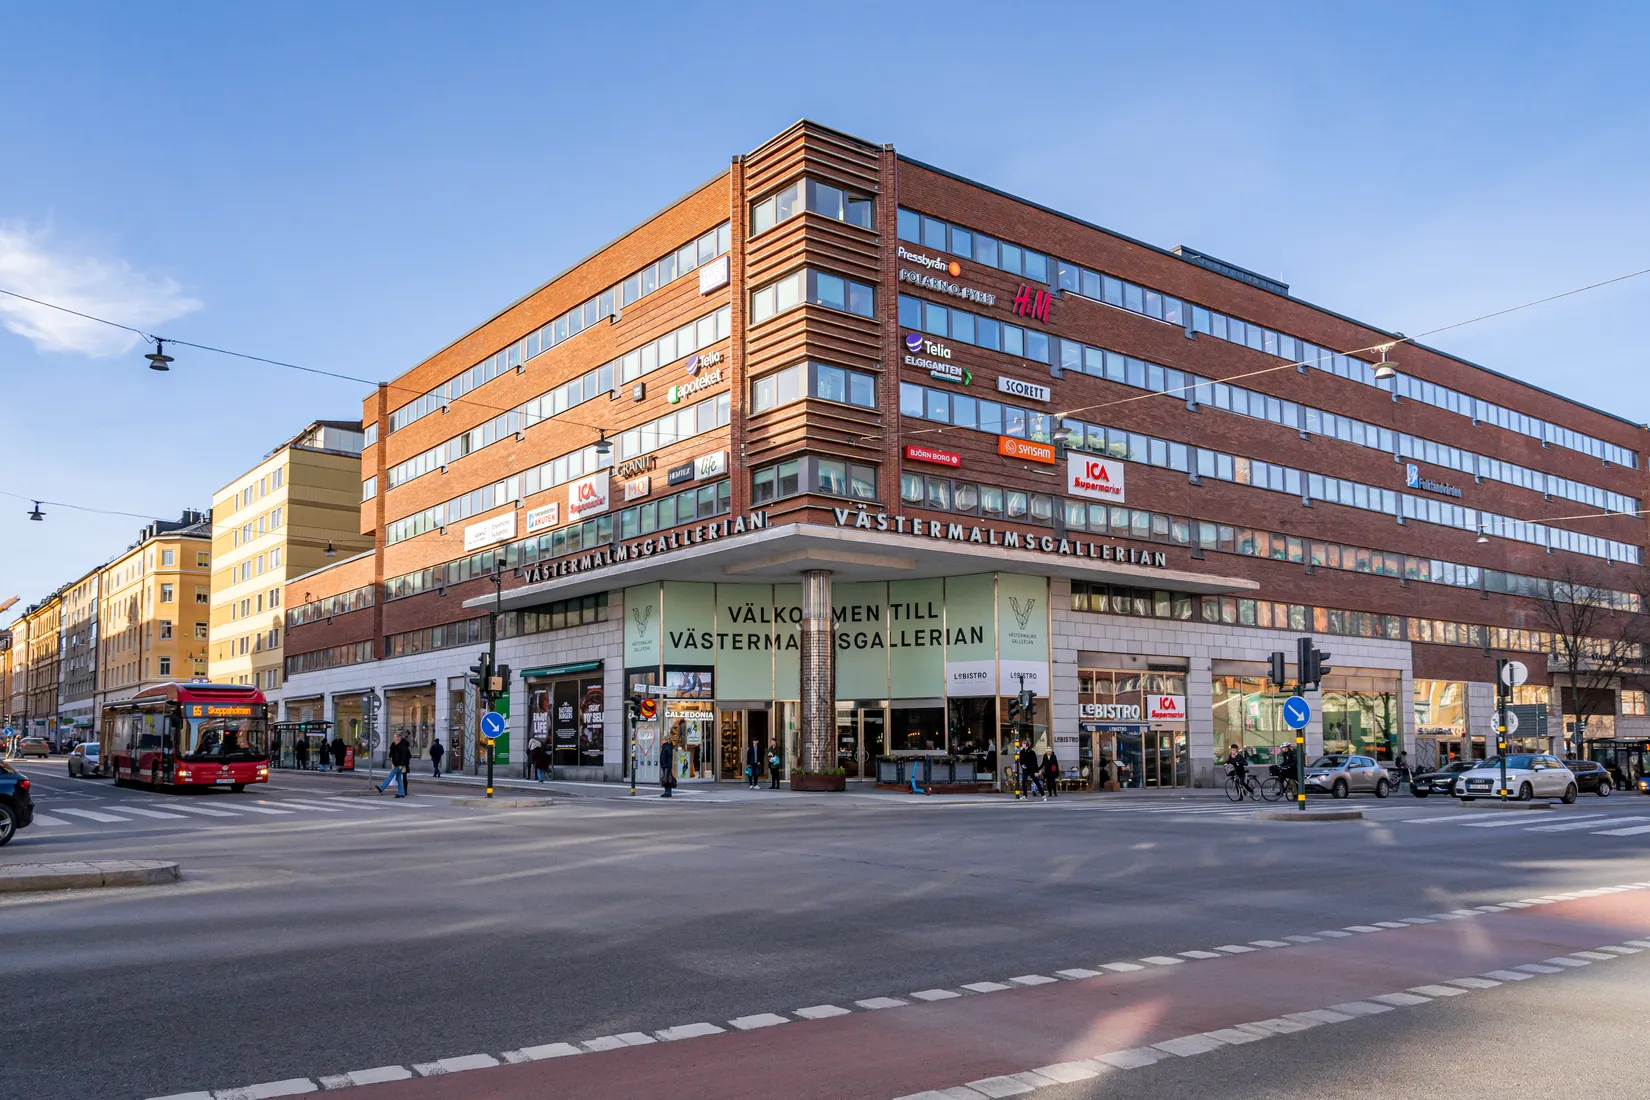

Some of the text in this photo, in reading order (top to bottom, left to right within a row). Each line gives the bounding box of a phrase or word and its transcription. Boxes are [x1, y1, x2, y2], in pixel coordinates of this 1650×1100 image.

[898, 246, 946, 271] Pressbyrån
[900, 268, 949, 293] POLARN
[962, 287, 996, 306] PYRET
[1013, 283, 1051, 323] H&M
[924, 340, 951, 359] Telia
[700, 351, 720, 369] Telia
[904, 355, 962, 376] ELGIGANTEN
[678, 368, 722, 399] apoteket
[1006, 380, 1044, 399] SCORETT
[910, 449, 951, 462] BJÖRN BORG
[1018, 444, 1051, 459] SYNSAM
[617, 455, 656, 478] GRANIT
[669, 467, 691, 480] HEMTEX
[701, 456, 717, 475] life
[1086, 460, 1109, 482] ICA
[578, 482, 597, 501] ICA
[628, 480, 645, 497] MQ
[1073, 476, 1122, 494] Supermarket
[534, 513, 556, 527] AKUTEN
[832, 503, 1167, 567] VÄSTERMALMSGALLERIAN
[524, 510, 768, 584] VÄSTERMALMSGALLERIAN
[728, 602, 939, 623] VÄLKOMEN TILL
[669, 626, 983, 651] VÄSTERMASGALLERIAN
[193, 705, 252, 717] 65 Skeppsholmen
[1159, 696, 1176, 710] ICA
[664, 711, 714, 719] CALZEDONIA
[533, 722, 547, 734] LIFE
